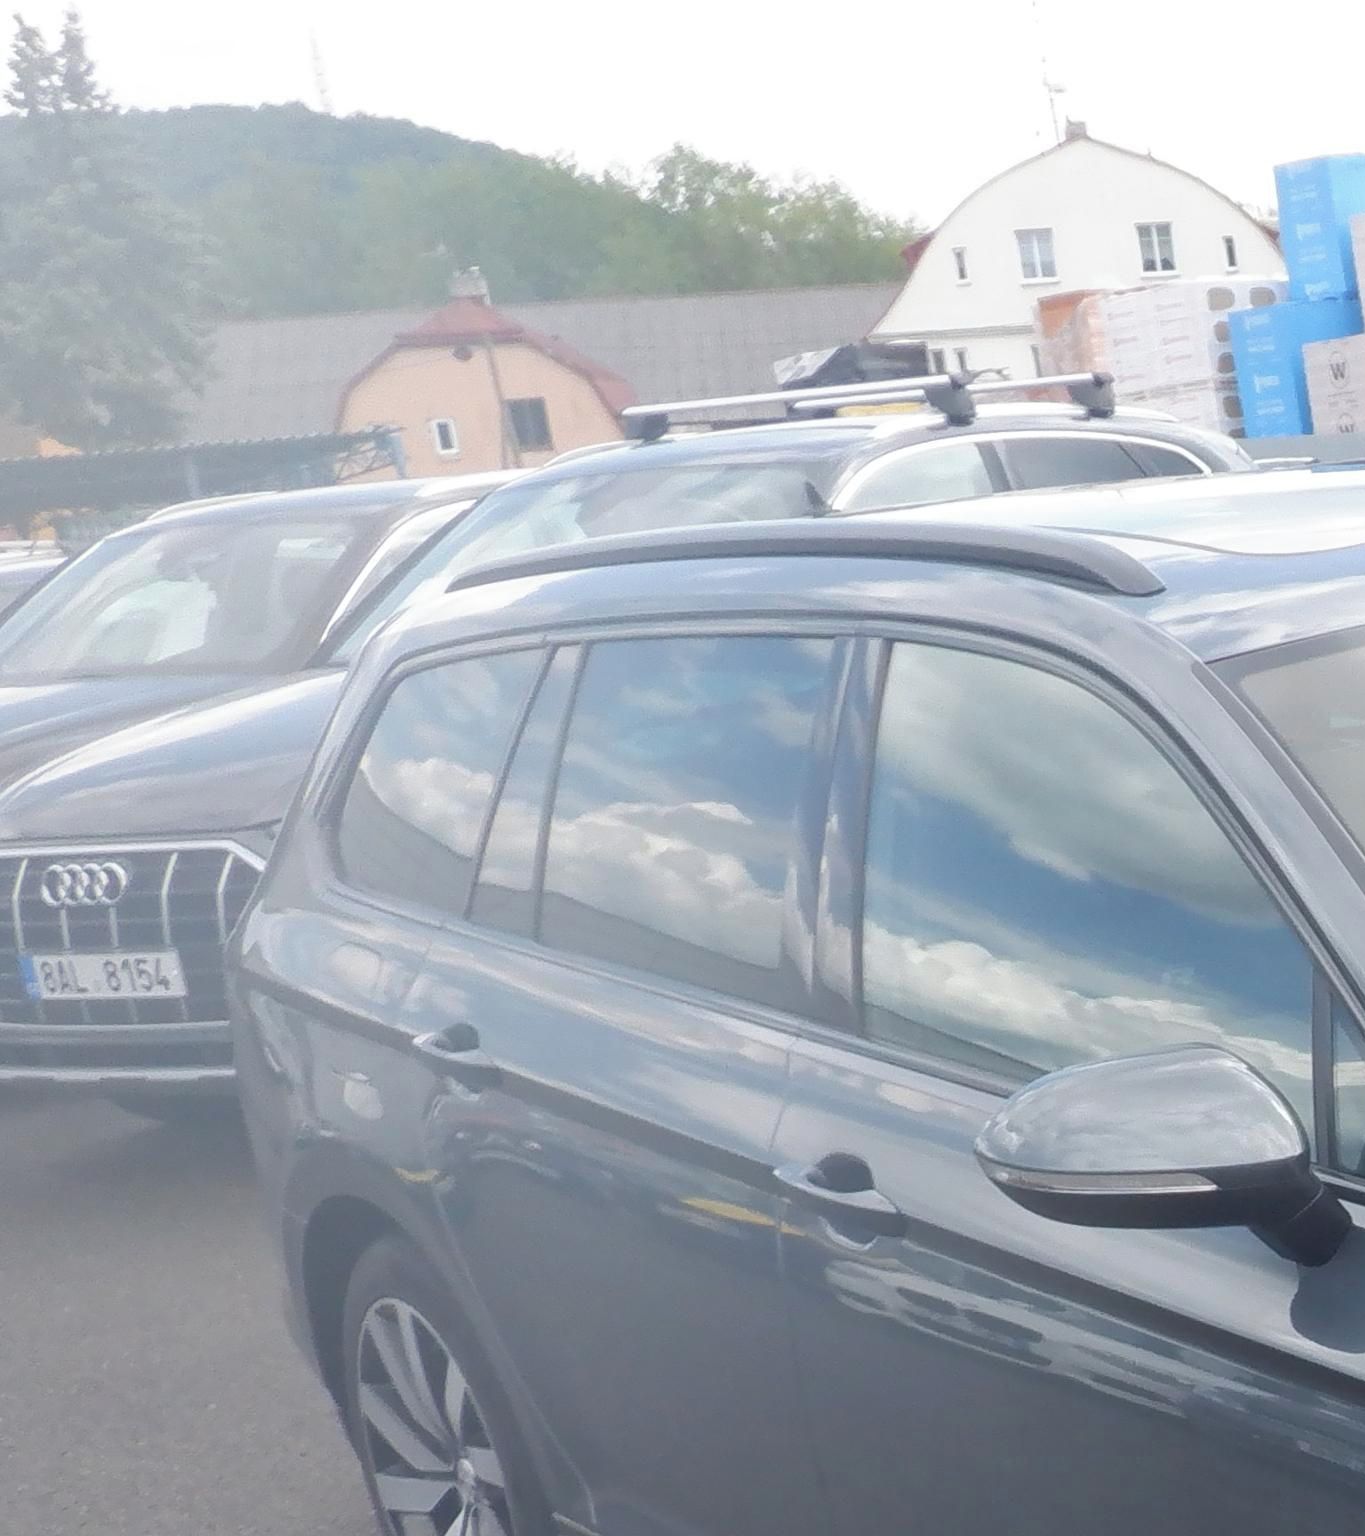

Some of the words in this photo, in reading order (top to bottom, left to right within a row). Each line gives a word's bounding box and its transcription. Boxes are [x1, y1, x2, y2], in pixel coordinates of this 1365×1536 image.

[1329, 362, 1347, 381] W
[40, 960, 88, 994] 8AL
[103, 958, 170, 992] 8154
